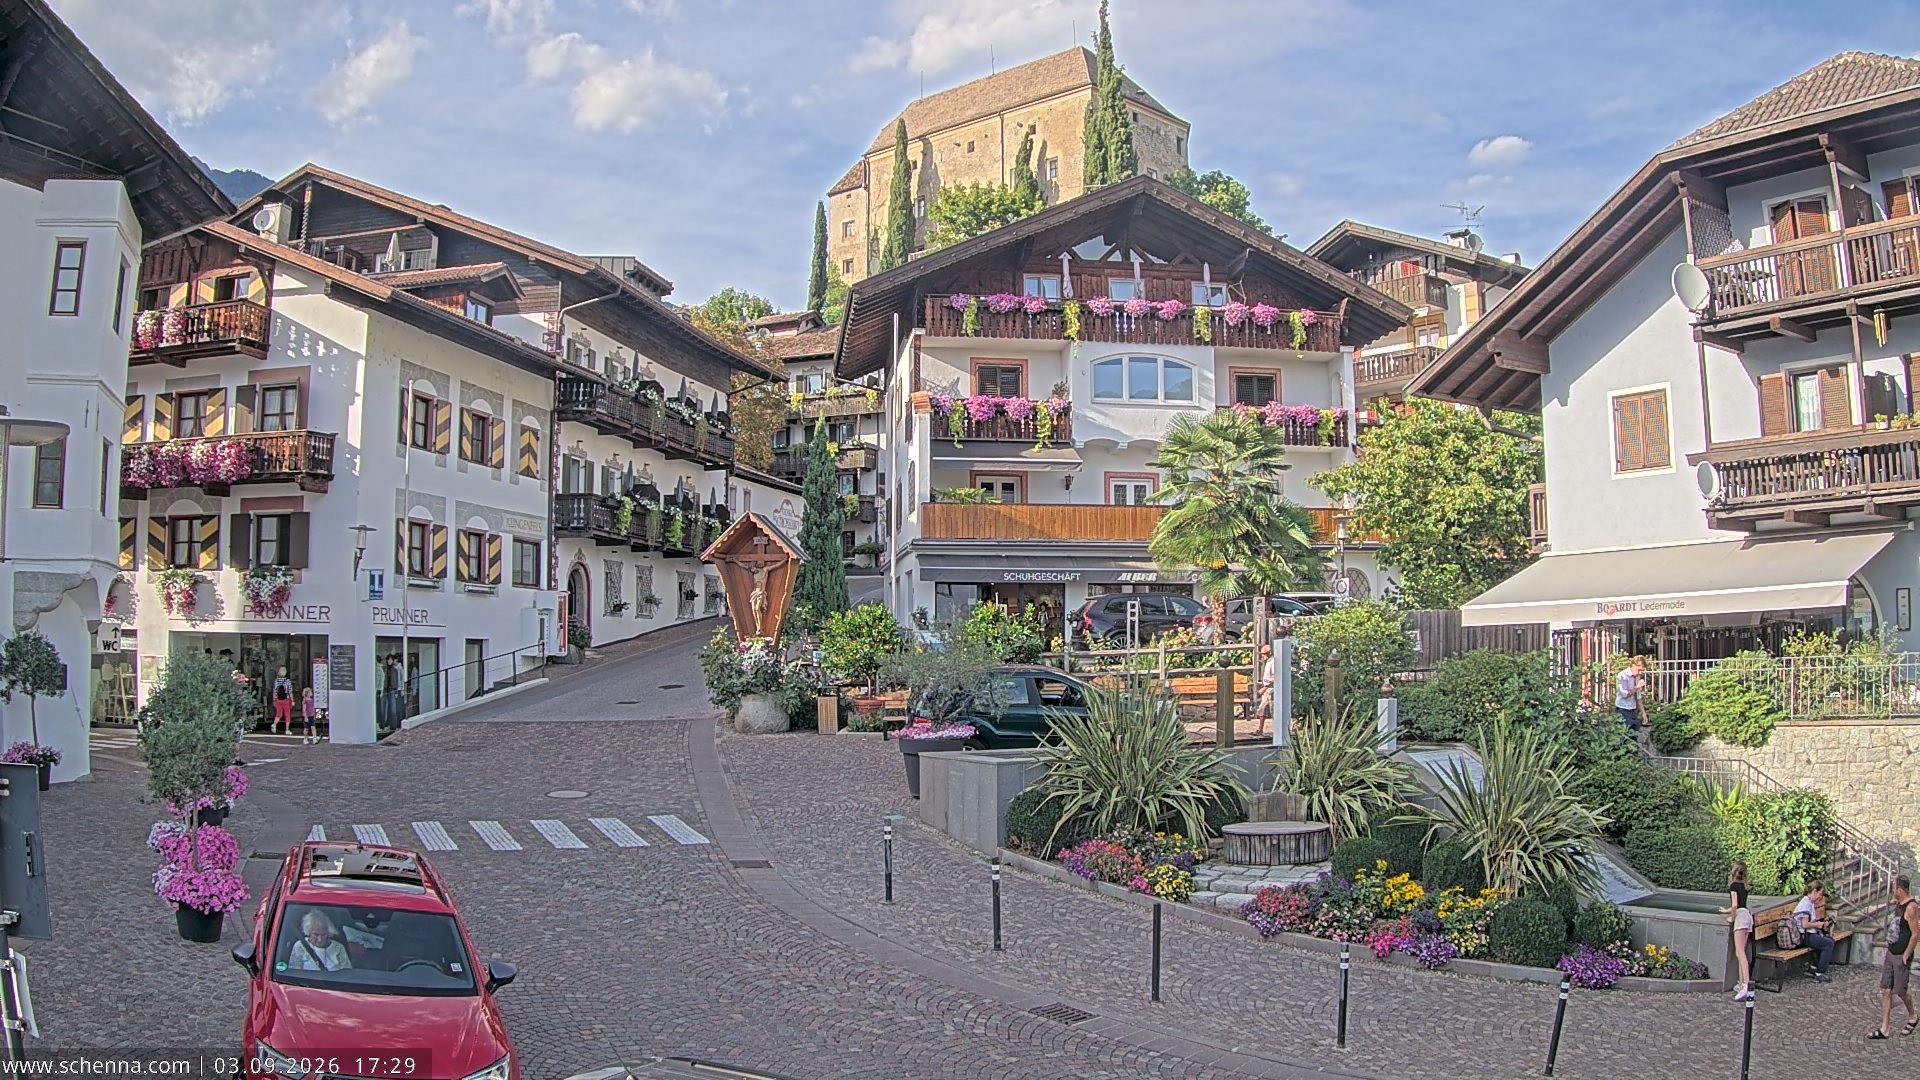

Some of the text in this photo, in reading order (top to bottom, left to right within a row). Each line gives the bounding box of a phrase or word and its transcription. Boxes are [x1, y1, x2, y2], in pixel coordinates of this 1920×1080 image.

[1003, 572, 1081, 581] SCHUHGESCHÄFT
[1640, 600, 1686, 611] Ledermode
[372, 606, 429, 623] PRUNNER
[102, 640, 118, 651] WC
